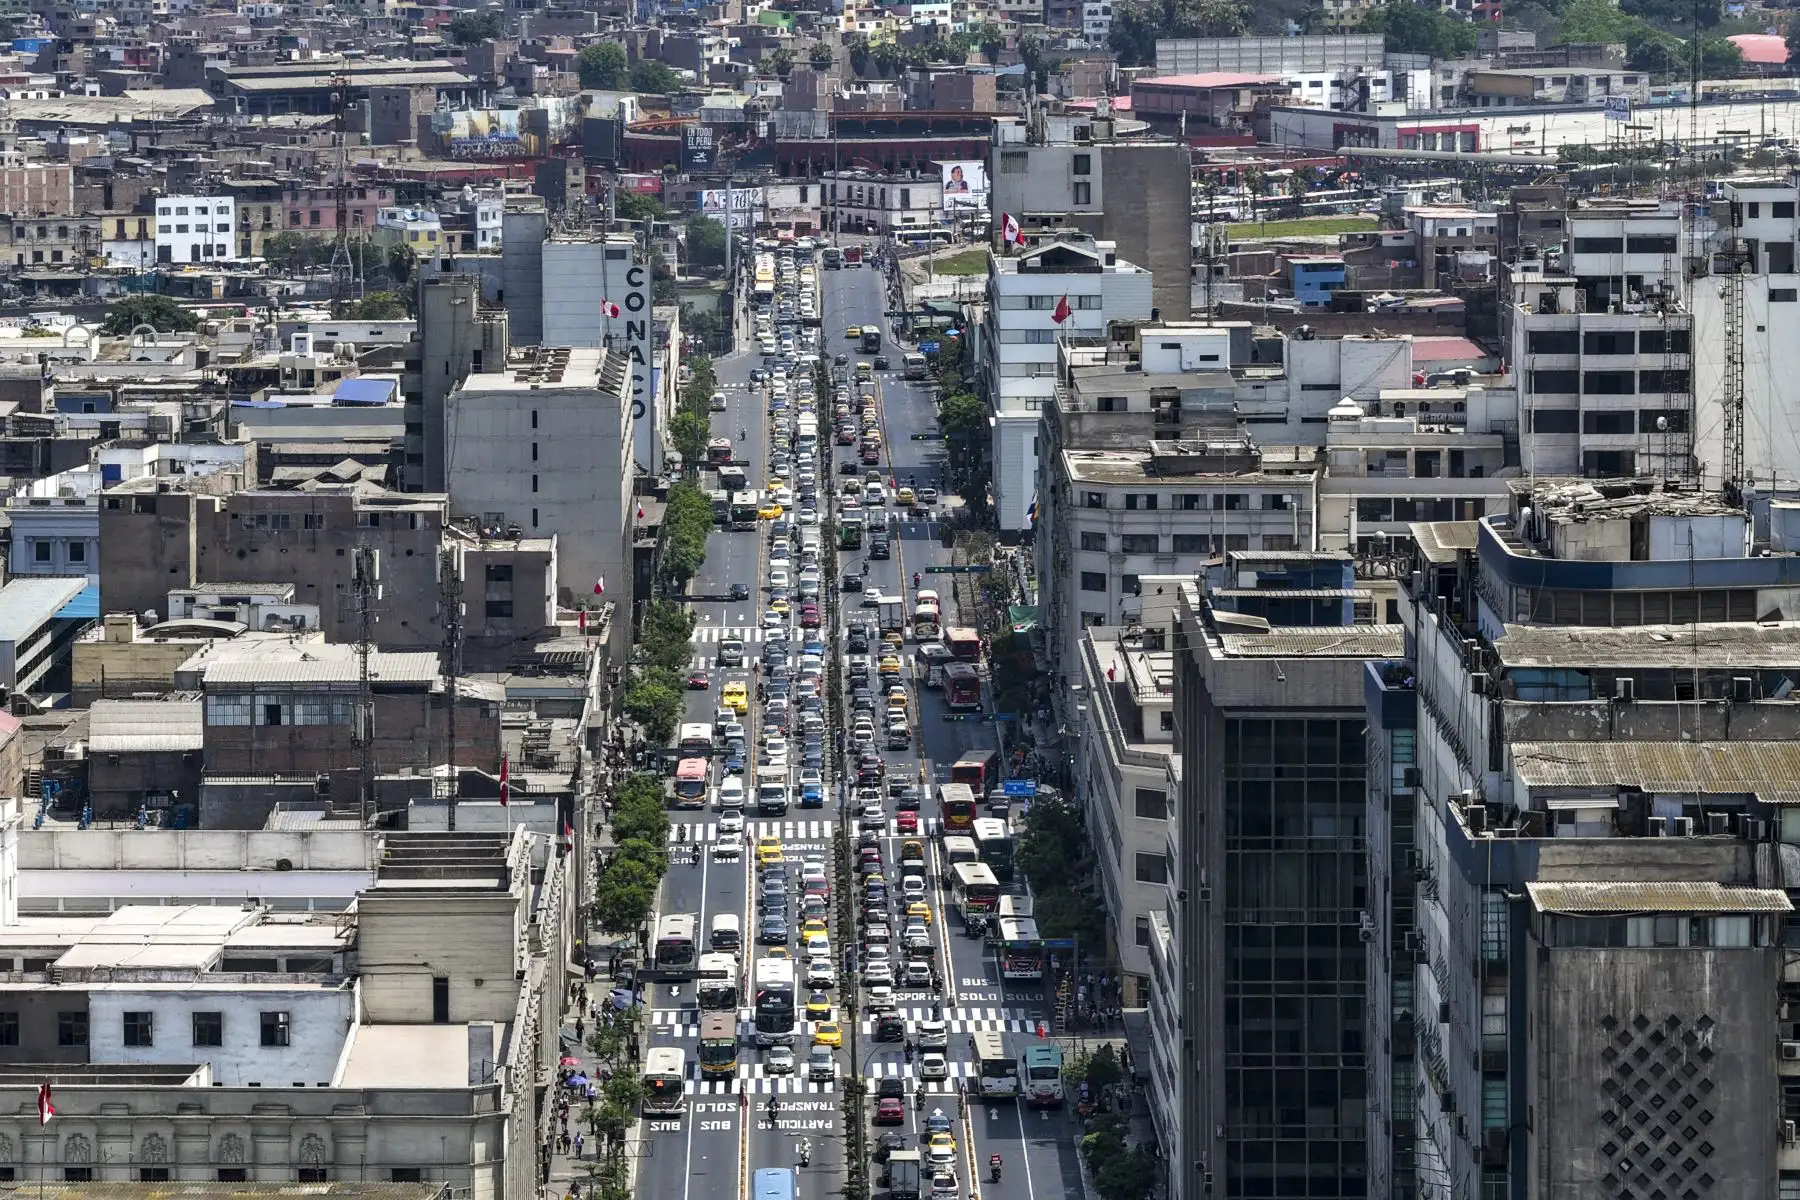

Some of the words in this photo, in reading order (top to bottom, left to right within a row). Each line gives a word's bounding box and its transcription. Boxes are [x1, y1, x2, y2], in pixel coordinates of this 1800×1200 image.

[687, 128, 695, 136] EN
[696, 128, 713, 136] TODO
[688, 137, 694, 145] EL
[625, 268, 646, 420] CONACO
[696, 1103, 736, 1112] SOLO
[756, 1102, 835, 1112] TRANSPOE
[650, 1122, 680, 1131] BUS
[700, 1120, 731, 1130] BUS
[758, 1120, 833, 1129] PARTICULAR
